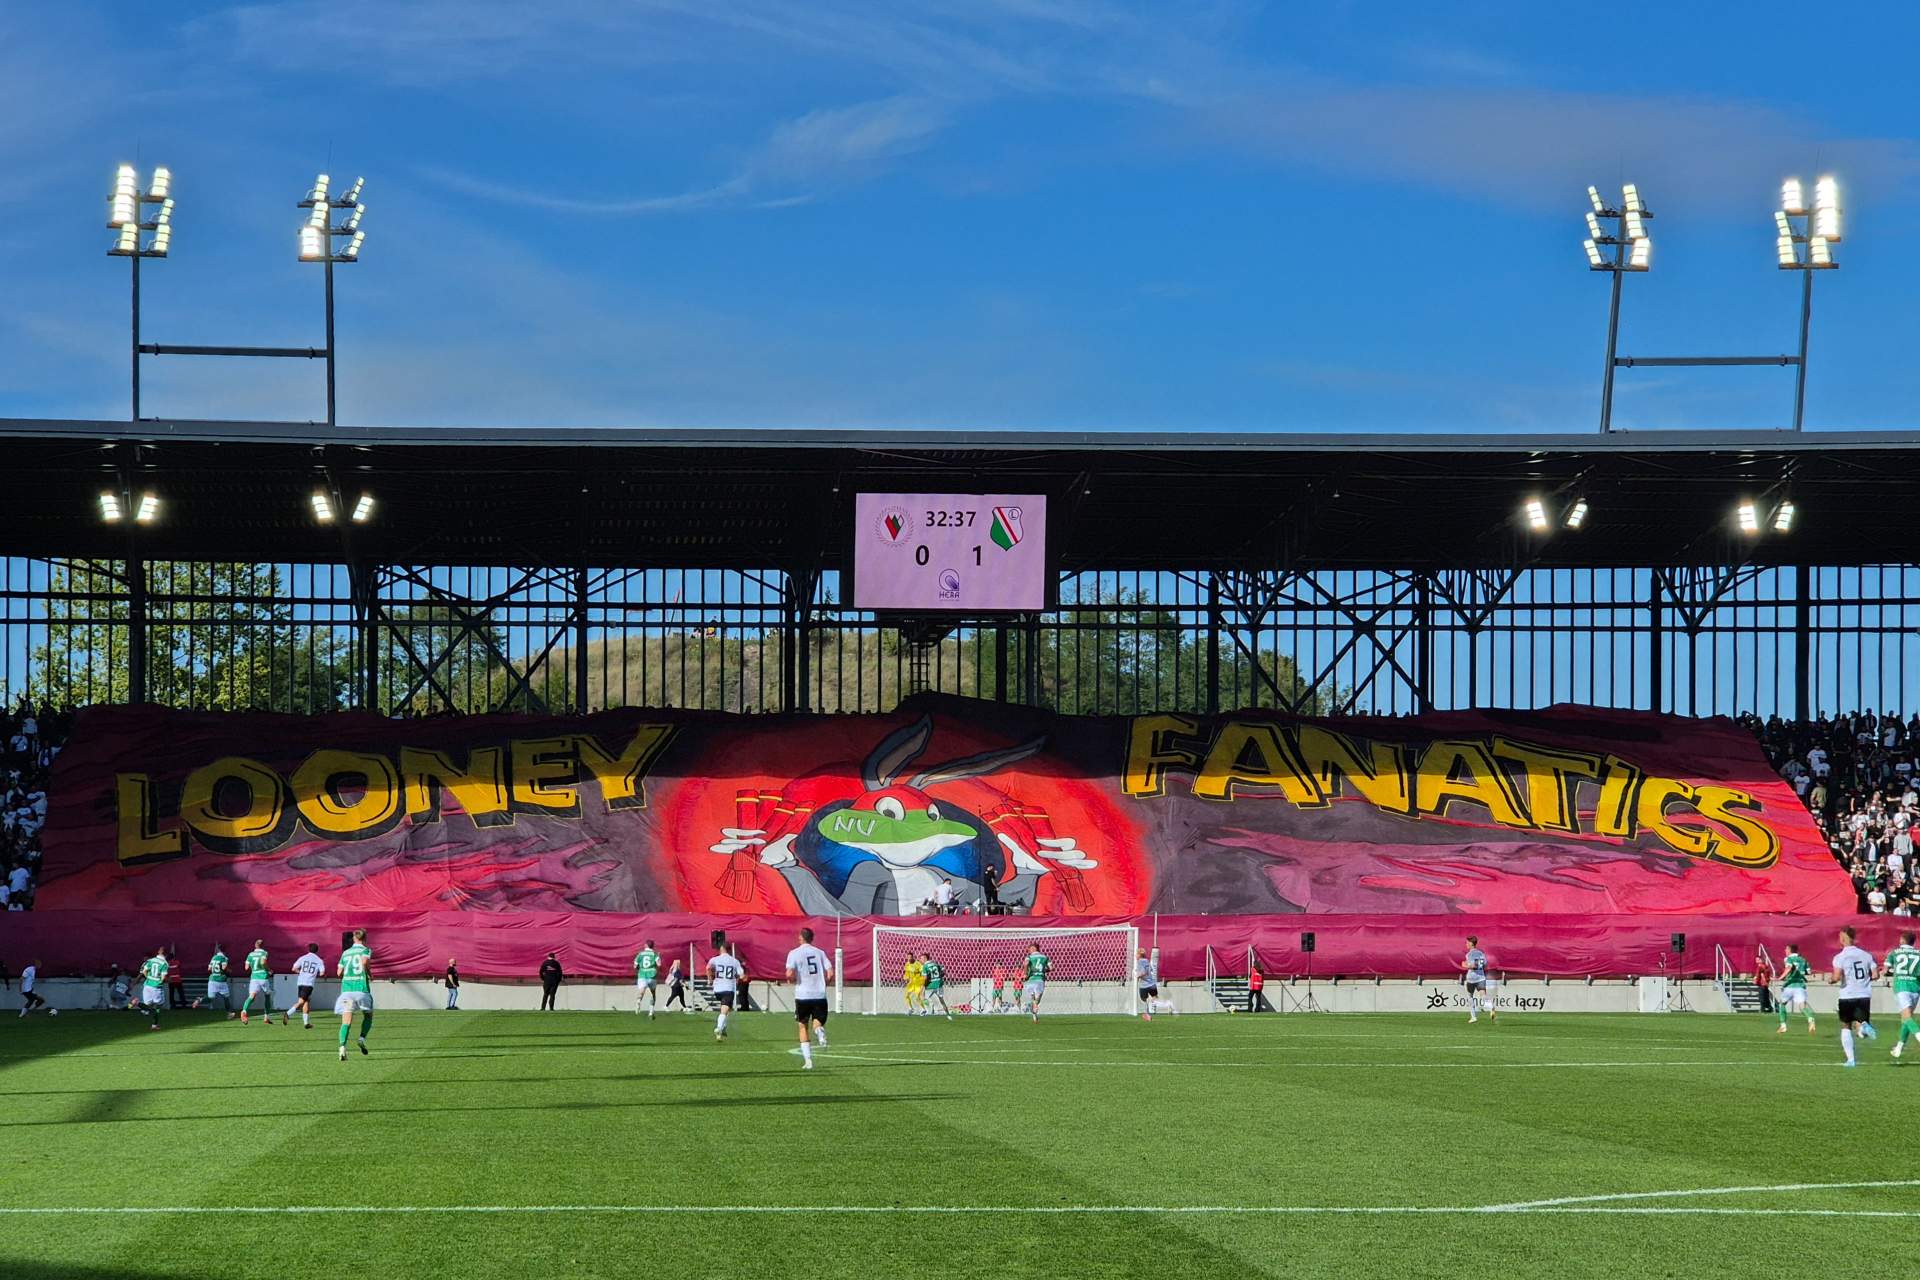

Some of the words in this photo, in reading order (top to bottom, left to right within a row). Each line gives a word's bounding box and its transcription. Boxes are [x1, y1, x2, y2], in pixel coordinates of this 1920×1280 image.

[926, 511, 976, 527] 32:37
[915, 545, 930, 566] 0
[972, 545, 982, 566] 1
[115, 724, 677, 867] LOONEY
[1121, 716, 1779, 869] FANATICS
[343, 954, 362, 976] 79
[642, 955, 652, 969] 6
[806, 956, 818, 975] 5
[1852, 961, 1865, 980] 6
[1895, 953, 1920, 975] 27
[1453, 993, 1512, 1007] Sonoiec
[1515, 994, 1546, 1011] łączy
